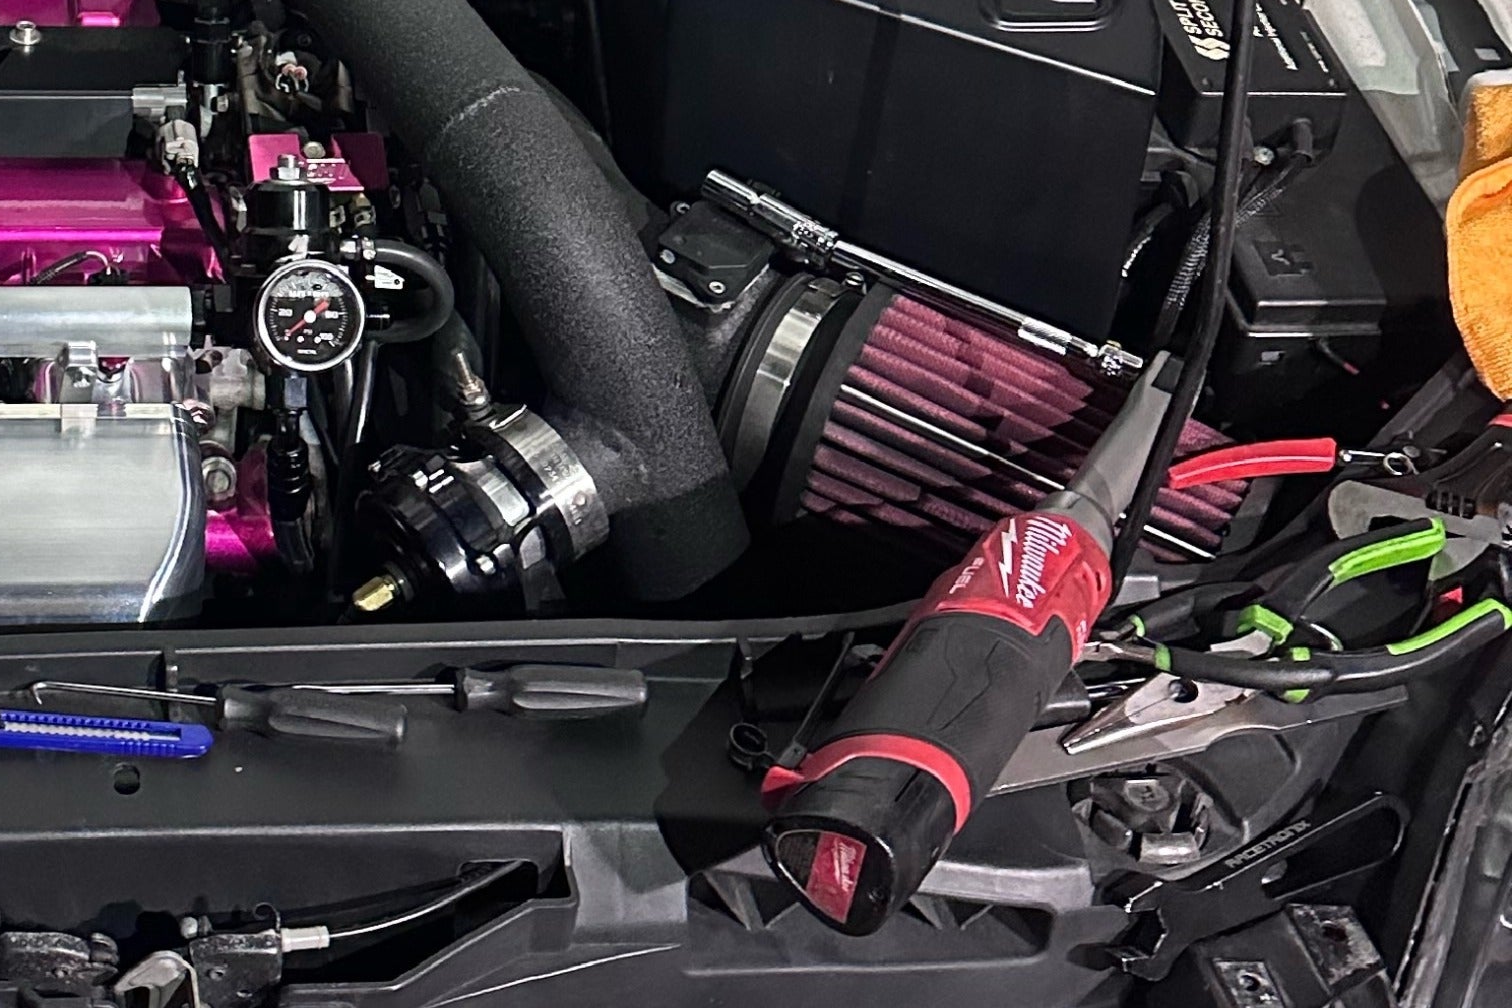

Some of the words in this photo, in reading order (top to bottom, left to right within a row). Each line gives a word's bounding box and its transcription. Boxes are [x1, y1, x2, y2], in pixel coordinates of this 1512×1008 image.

[1168, 0, 1202, 35] SPLIT
[949, 557, 985, 595] FUEL
[1015, 516, 1073, 609] Milwaukee
[1224, 819, 1312, 869] RACETRONIX
